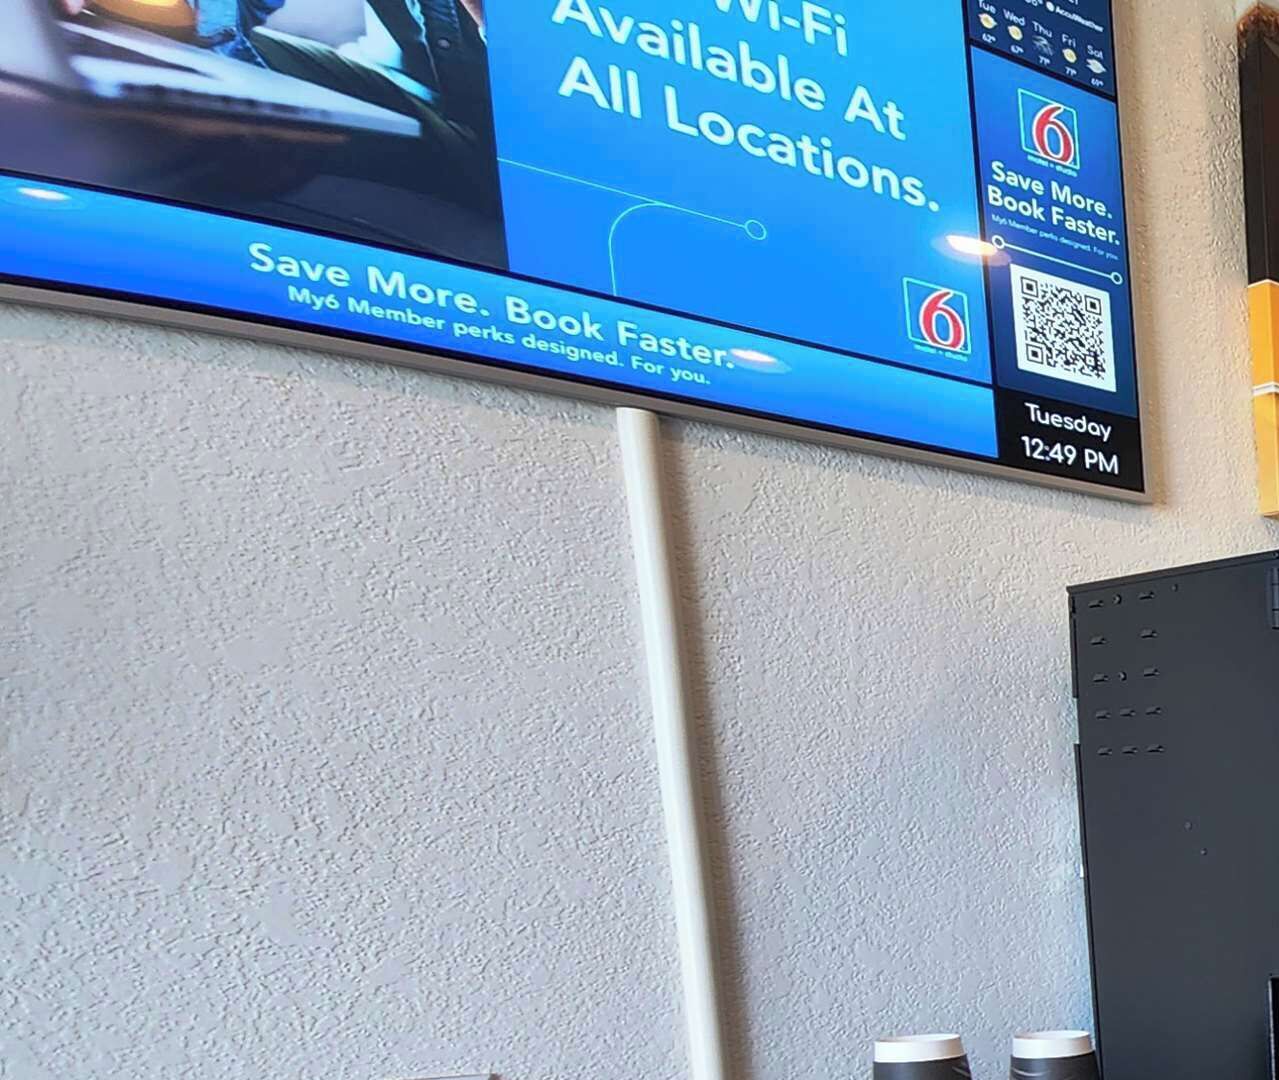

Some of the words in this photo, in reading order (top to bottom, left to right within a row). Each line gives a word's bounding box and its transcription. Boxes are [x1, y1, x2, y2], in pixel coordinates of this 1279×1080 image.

[1003, 9, 1026, 26] Wed
[1032, 21, 1053, 38] Thu
[1061, 34, 1077, 48] Fri
[1086, 45, 1104, 60] Sat
[551, 0, 826, 111] Available
[844, 84, 907, 141] At
[557, 55, 642, 119] All
[663, 84, 940, 213] Locations.
[1031, 102, 1075, 165] 6
[987, 184, 1046, 222] Book
[1051, 206, 1121, 246] Faster.
[991, 160, 1045, 195] Save
[1051, 181, 1113, 219] More.
[248, 242, 351, 287] Save
[366, 265, 490, 317] More.
[505, 295, 604, 341] Book
[616, 320, 735, 369] Faster.
[287, 285, 341, 311] My6
[347, 296, 446, 330] Member
[452, 321, 516, 345] perks
[521, 333, 626, 368] designed.
[631, 355, 664, 375] For
[670, 366, 712, 385] you.
[919, 288, 966, 351] 6
[1024, 402, 1112, 442] Tuesday
[1020, 435, 1077, 466] 12:49
[1084, 450, 1120, 475] PM
